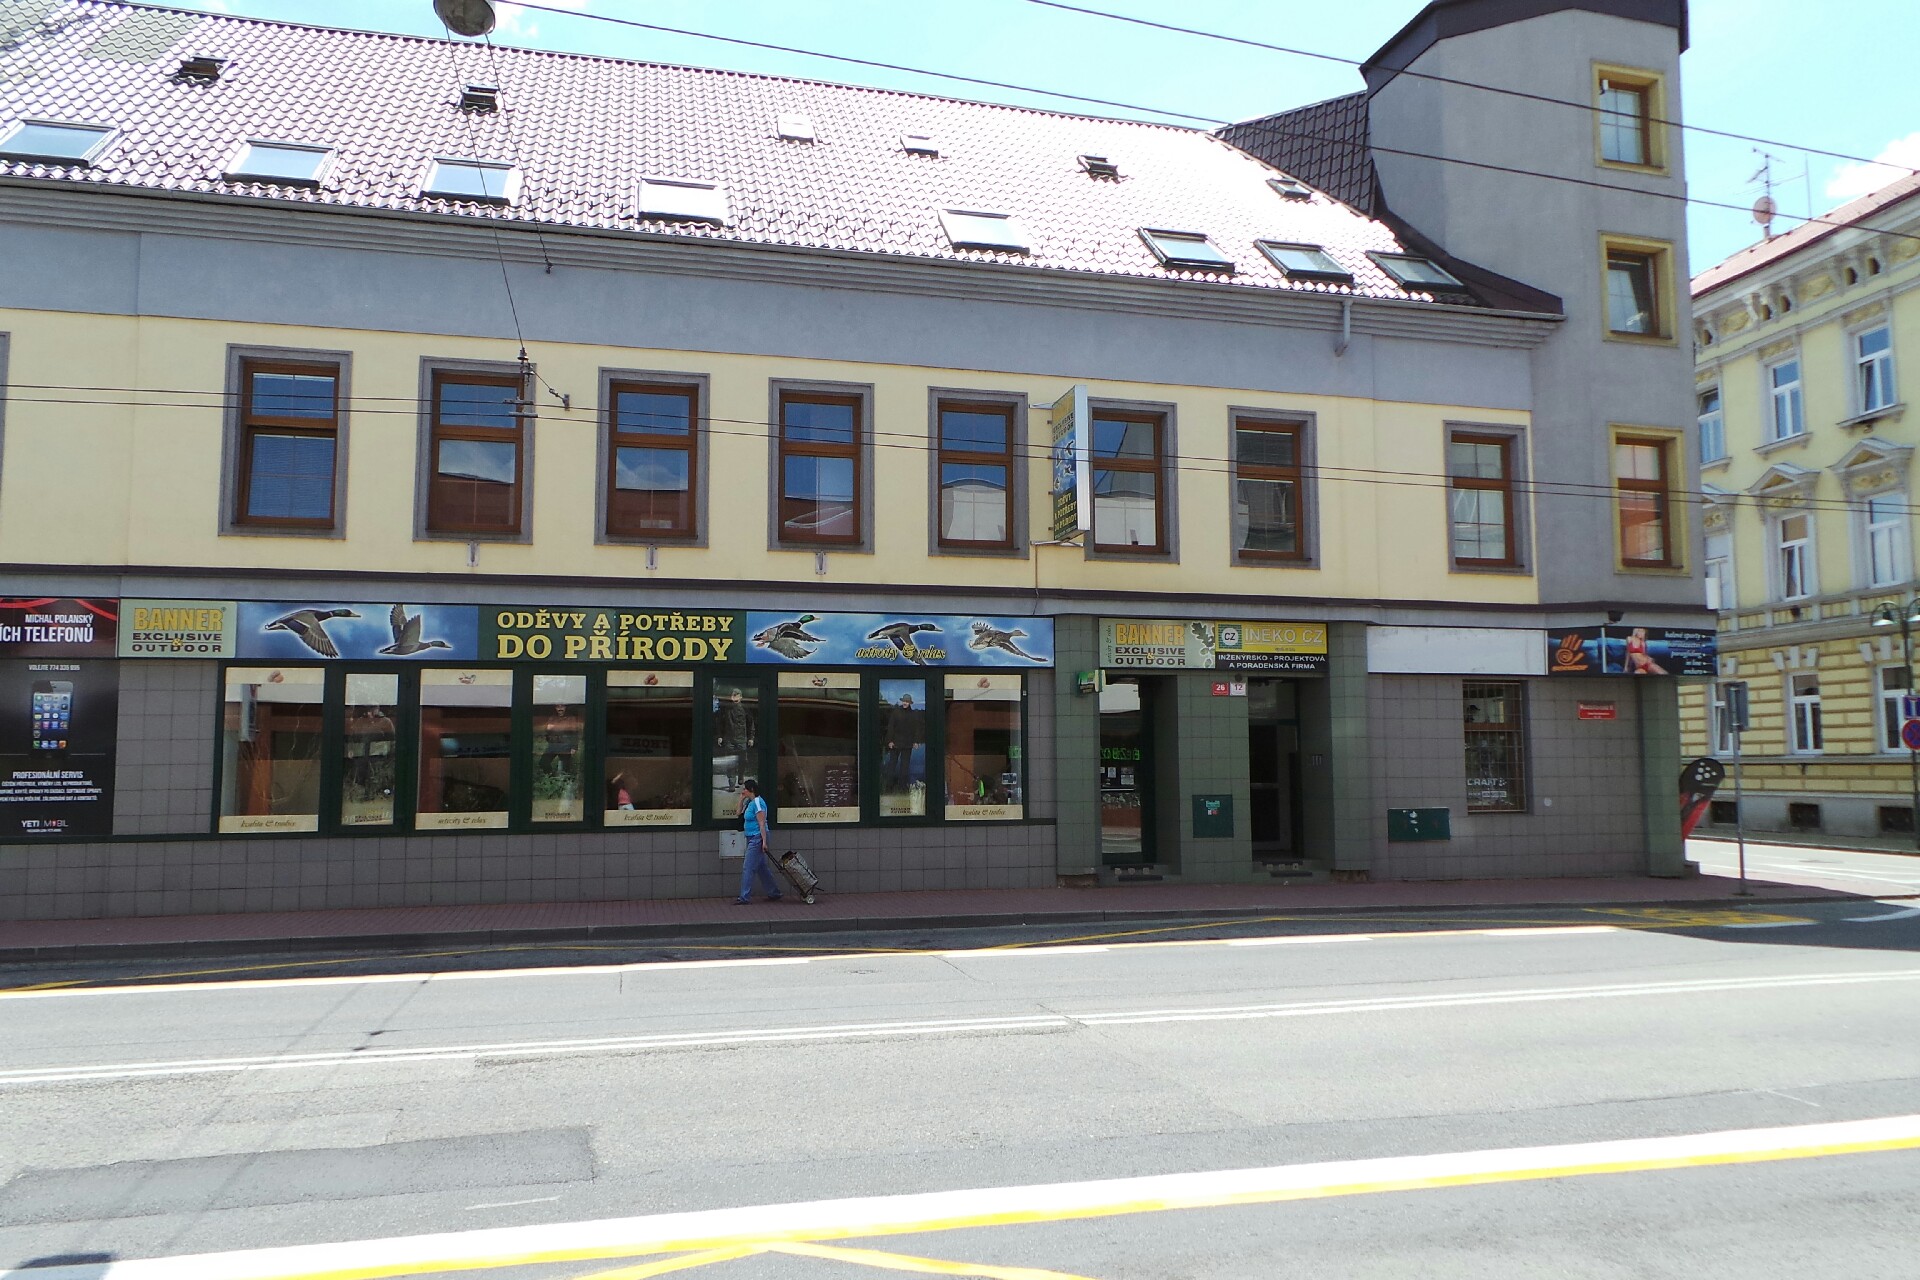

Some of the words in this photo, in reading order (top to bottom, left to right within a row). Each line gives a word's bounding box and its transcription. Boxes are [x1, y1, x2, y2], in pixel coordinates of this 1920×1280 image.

[25, 614, 53, 623] MICHAL
[54, 612, 93, 624] POLANSKÝ
[134, 608, 223, 631] BANNER
[497, 608, 587, 630] ODĚVY
[593, 614, 611, 629] A
[619, 612, 734, 632] POTŘEBY
[24, 622, 93, 643] TELEFONŮ
[1116, 624, 1185, 646] BANNER
[1246, 628, 1296, 642] INEKO
[1302, 629, 1323, 643] CZ
[132, 644, 222, 652] OUTDOOR
[497, 634, 552, 659] DO
[564, 630, 733, 661] PŘÍRODY
[13, 770, 60, 778] PROFESIONÁLNÍ
